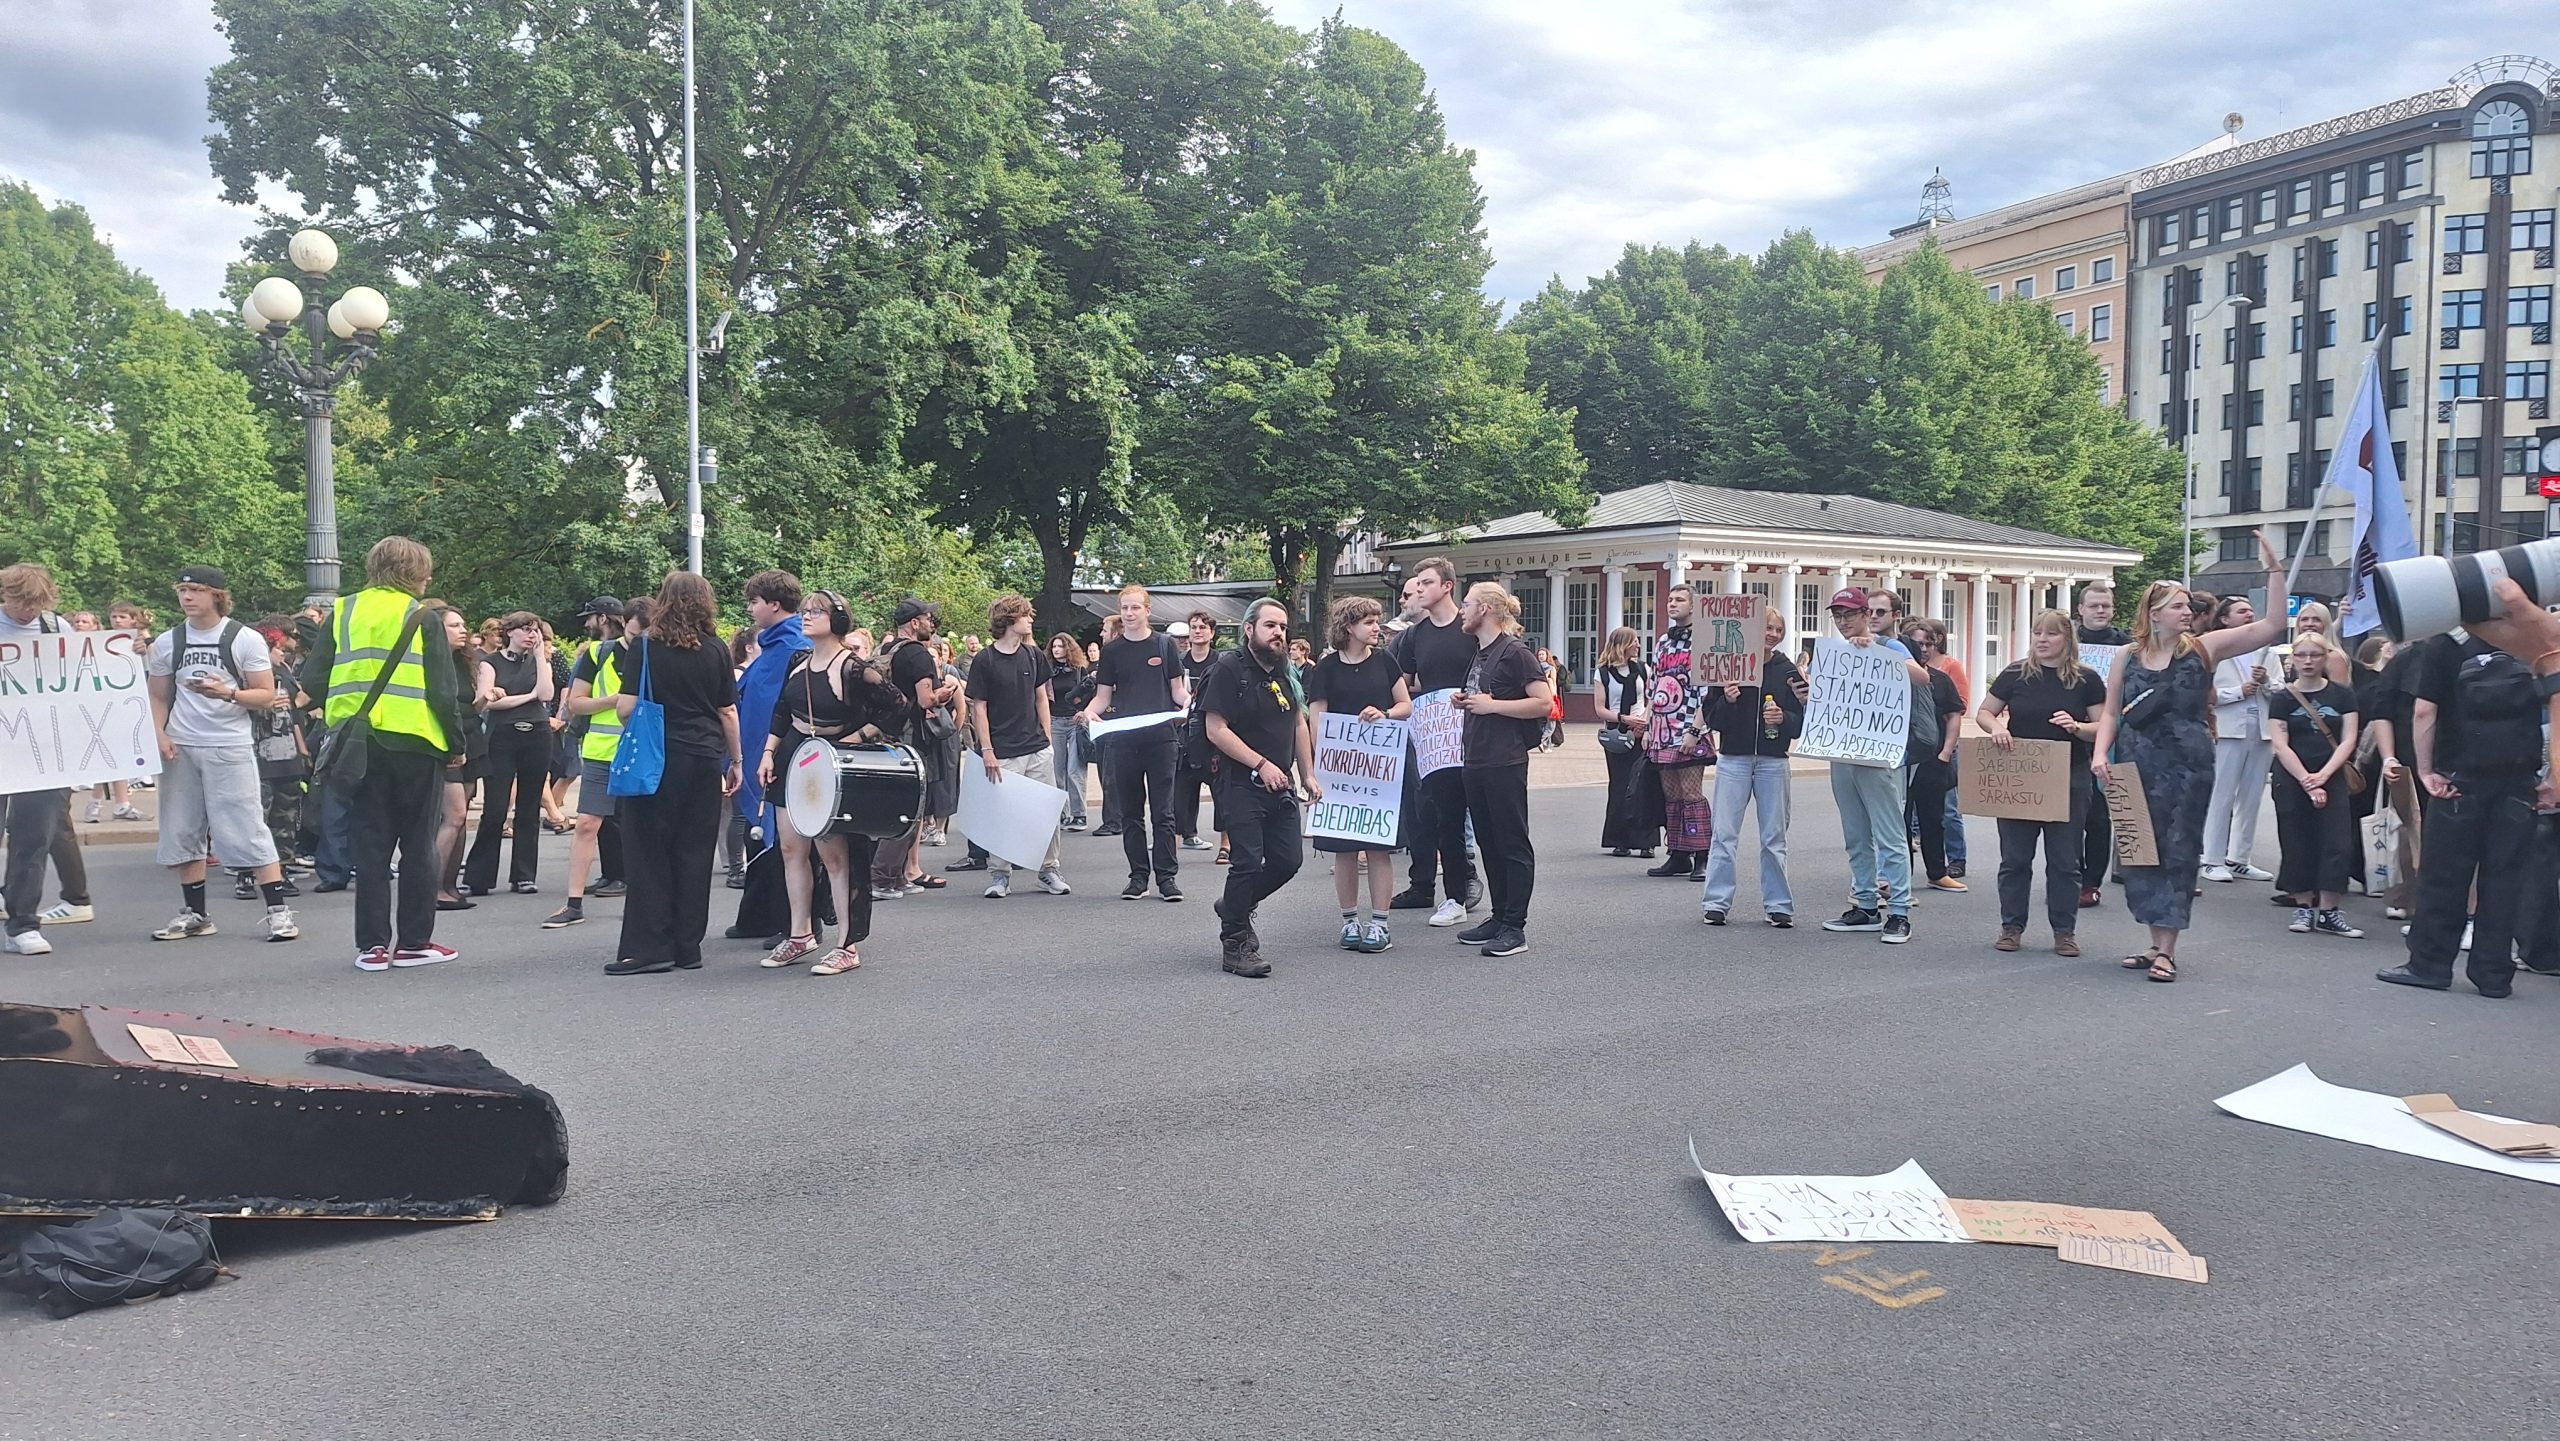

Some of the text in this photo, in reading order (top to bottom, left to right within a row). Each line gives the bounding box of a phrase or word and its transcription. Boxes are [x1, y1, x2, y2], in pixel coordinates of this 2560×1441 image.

[1703, 548, 1786, 559] WINE RESTAURANT
[1710, 620, 1744, 653] IR
[1816, 647, 1903, 681] VISPIRMS
[1812, 675, 1904, 711] STAMBULA
[1809, 700, 1904, 735] TAGAD NVO
[1802, 722, 1835, 748] KAD
[1331, 783, 1379, 796] NEVIS
[1978, 773, 2024, 787] NEVIS
[1979, 788, 2044, 806] SARAKSTU
[1312, 802, 1394, 837] BIEDRĪBAS
